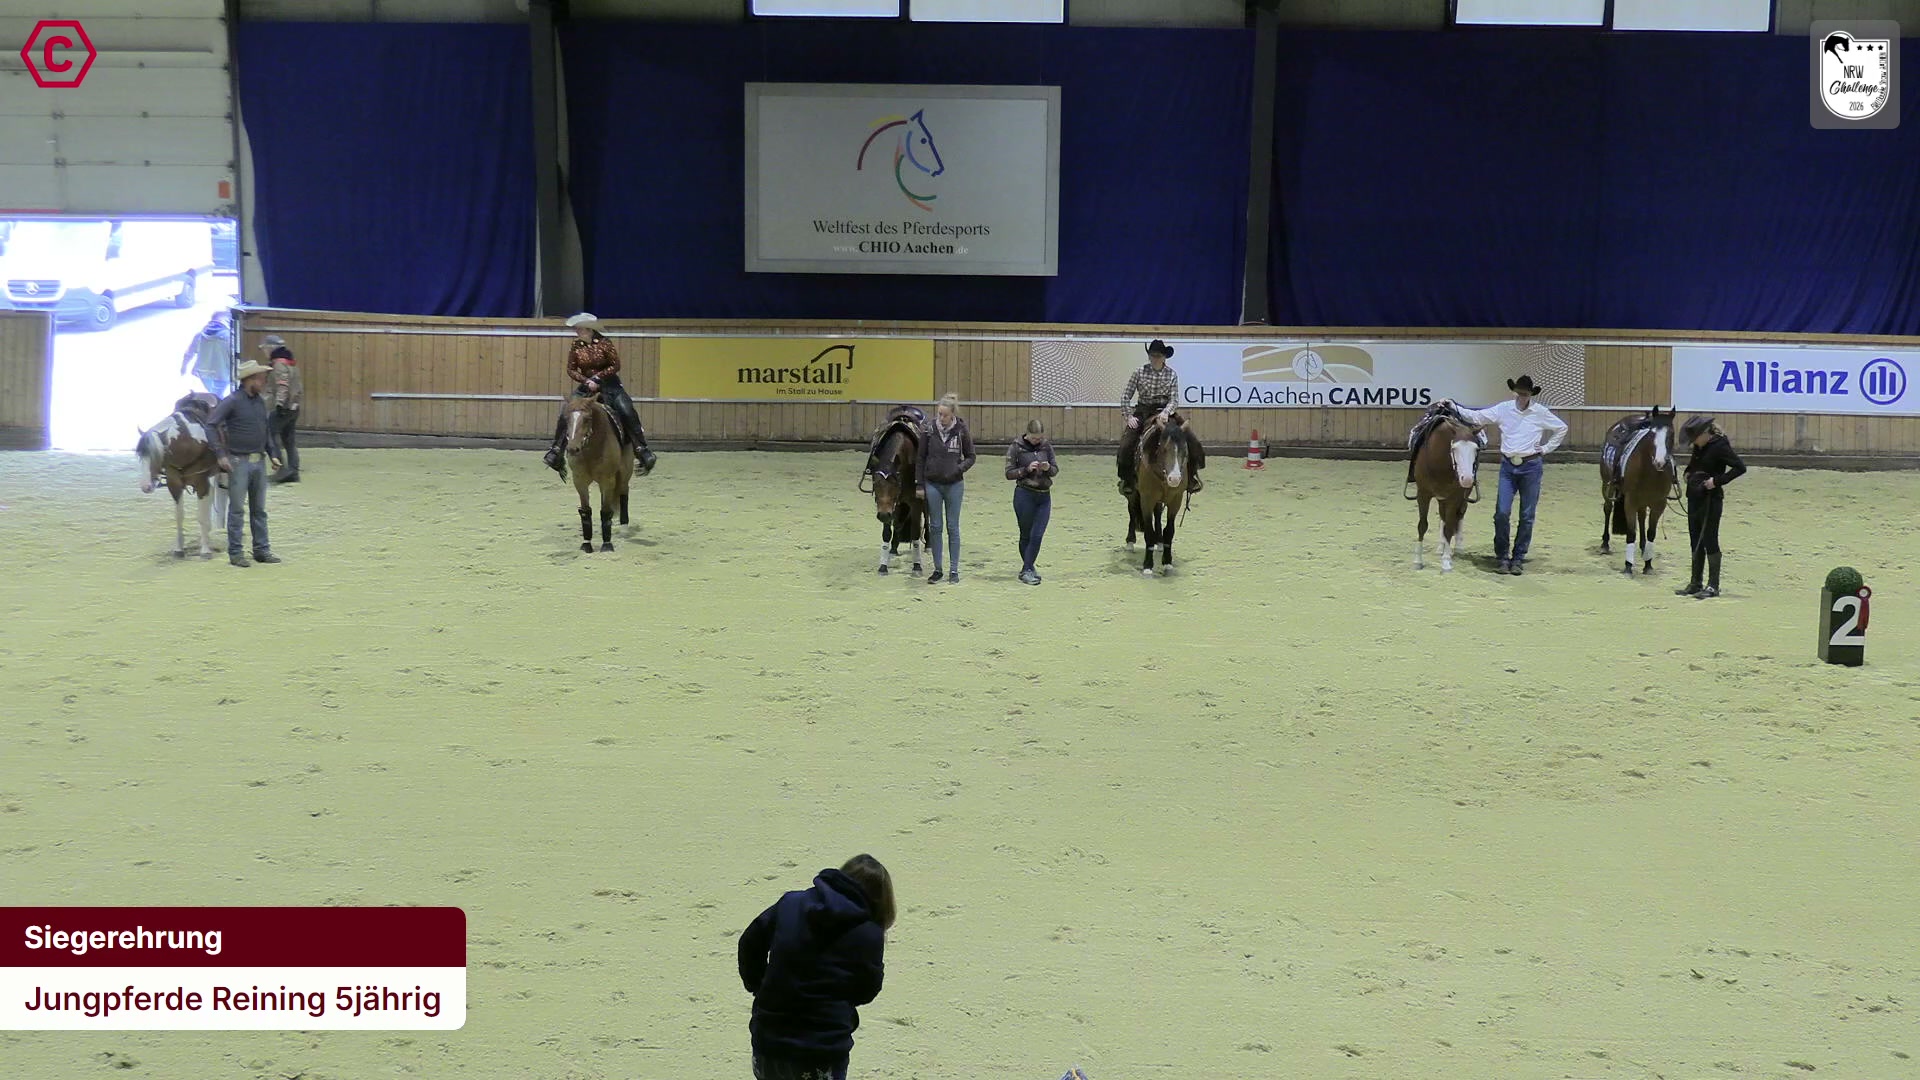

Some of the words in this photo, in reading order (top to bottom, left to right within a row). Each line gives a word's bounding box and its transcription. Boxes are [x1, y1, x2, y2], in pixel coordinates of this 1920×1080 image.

[813, 220, 870, 235] Weltfest
[874, 222, 898, 235] des
[903, 222, 990, 239] Pferdesports
[737, 362, 842, 384] marstall
[1715, 360, 1849, 395] Allianz
[776, 387, 787, 395] Im
[1184, 385, 1242, 404] CHIO
[1247, 386, 1323, 405] Aachen
[1328, 387, 1432, 406] CAMPUS
[1829, 595, 1865, 646] 2
